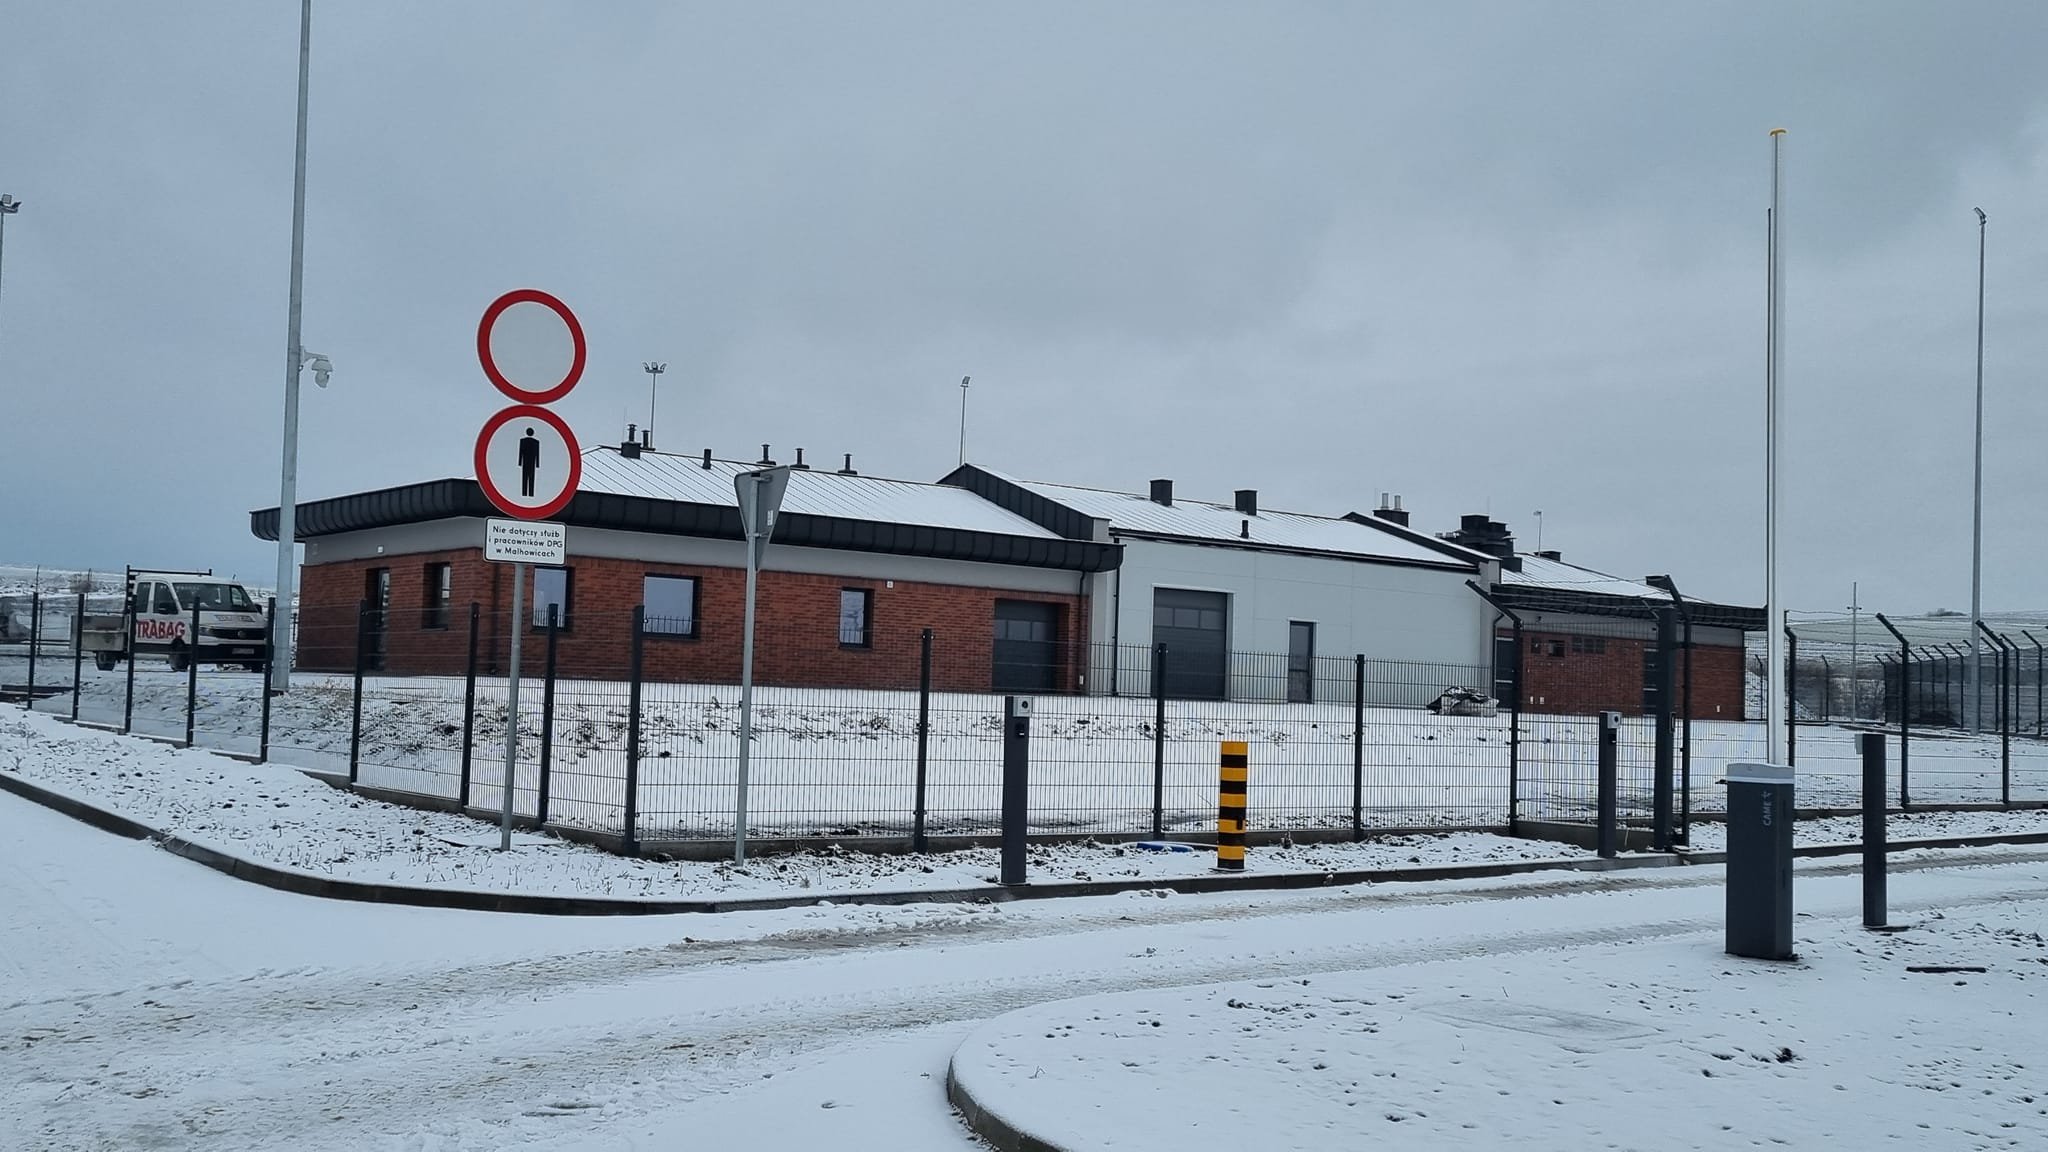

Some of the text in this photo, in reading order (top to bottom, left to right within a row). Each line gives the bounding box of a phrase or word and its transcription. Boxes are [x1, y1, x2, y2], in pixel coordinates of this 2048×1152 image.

[492, 525, 560, 538] Nie dotyczy służb
[494, 537, 544, 547] pracowników
[547, 540, 563, 548] DPG
[504, 547, 555, 557] Malhowicach
[135, 619, 186, 639] TRABAG
[1762, 801, 1772, 826] CAME
